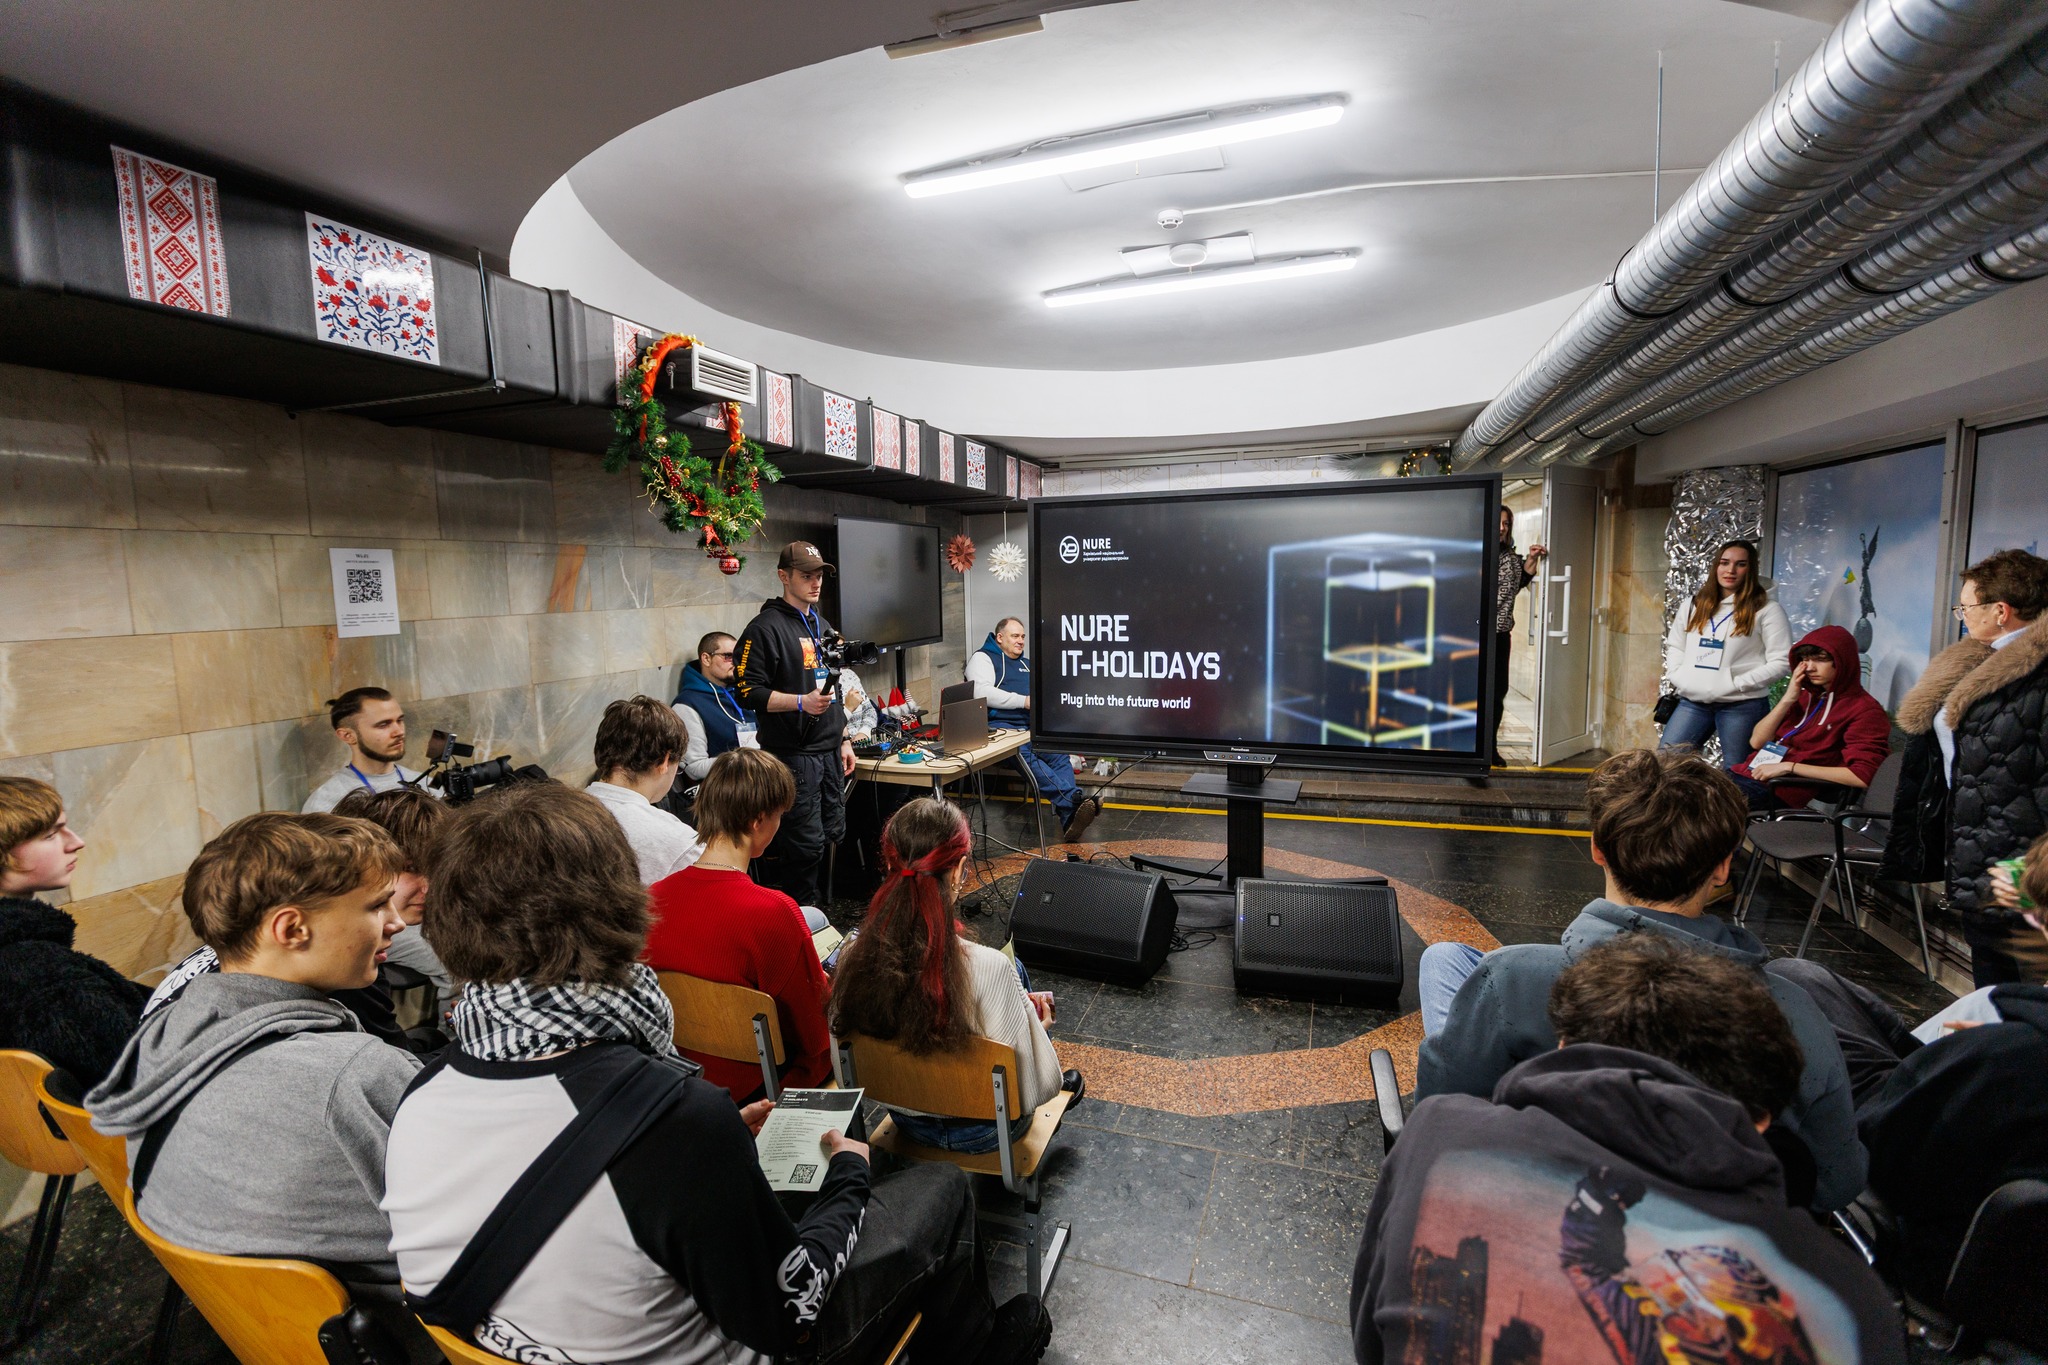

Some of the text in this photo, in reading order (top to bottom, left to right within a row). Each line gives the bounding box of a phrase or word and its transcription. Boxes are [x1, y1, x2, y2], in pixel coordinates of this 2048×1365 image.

[1082, 538, 1111, 550] NURE
[1061, 614, 1130, 642] NURE
[1061, 650, 1221, 681] IT-HOLIDAYS
[1060, 693, 1191, 709] Plug into the future world
